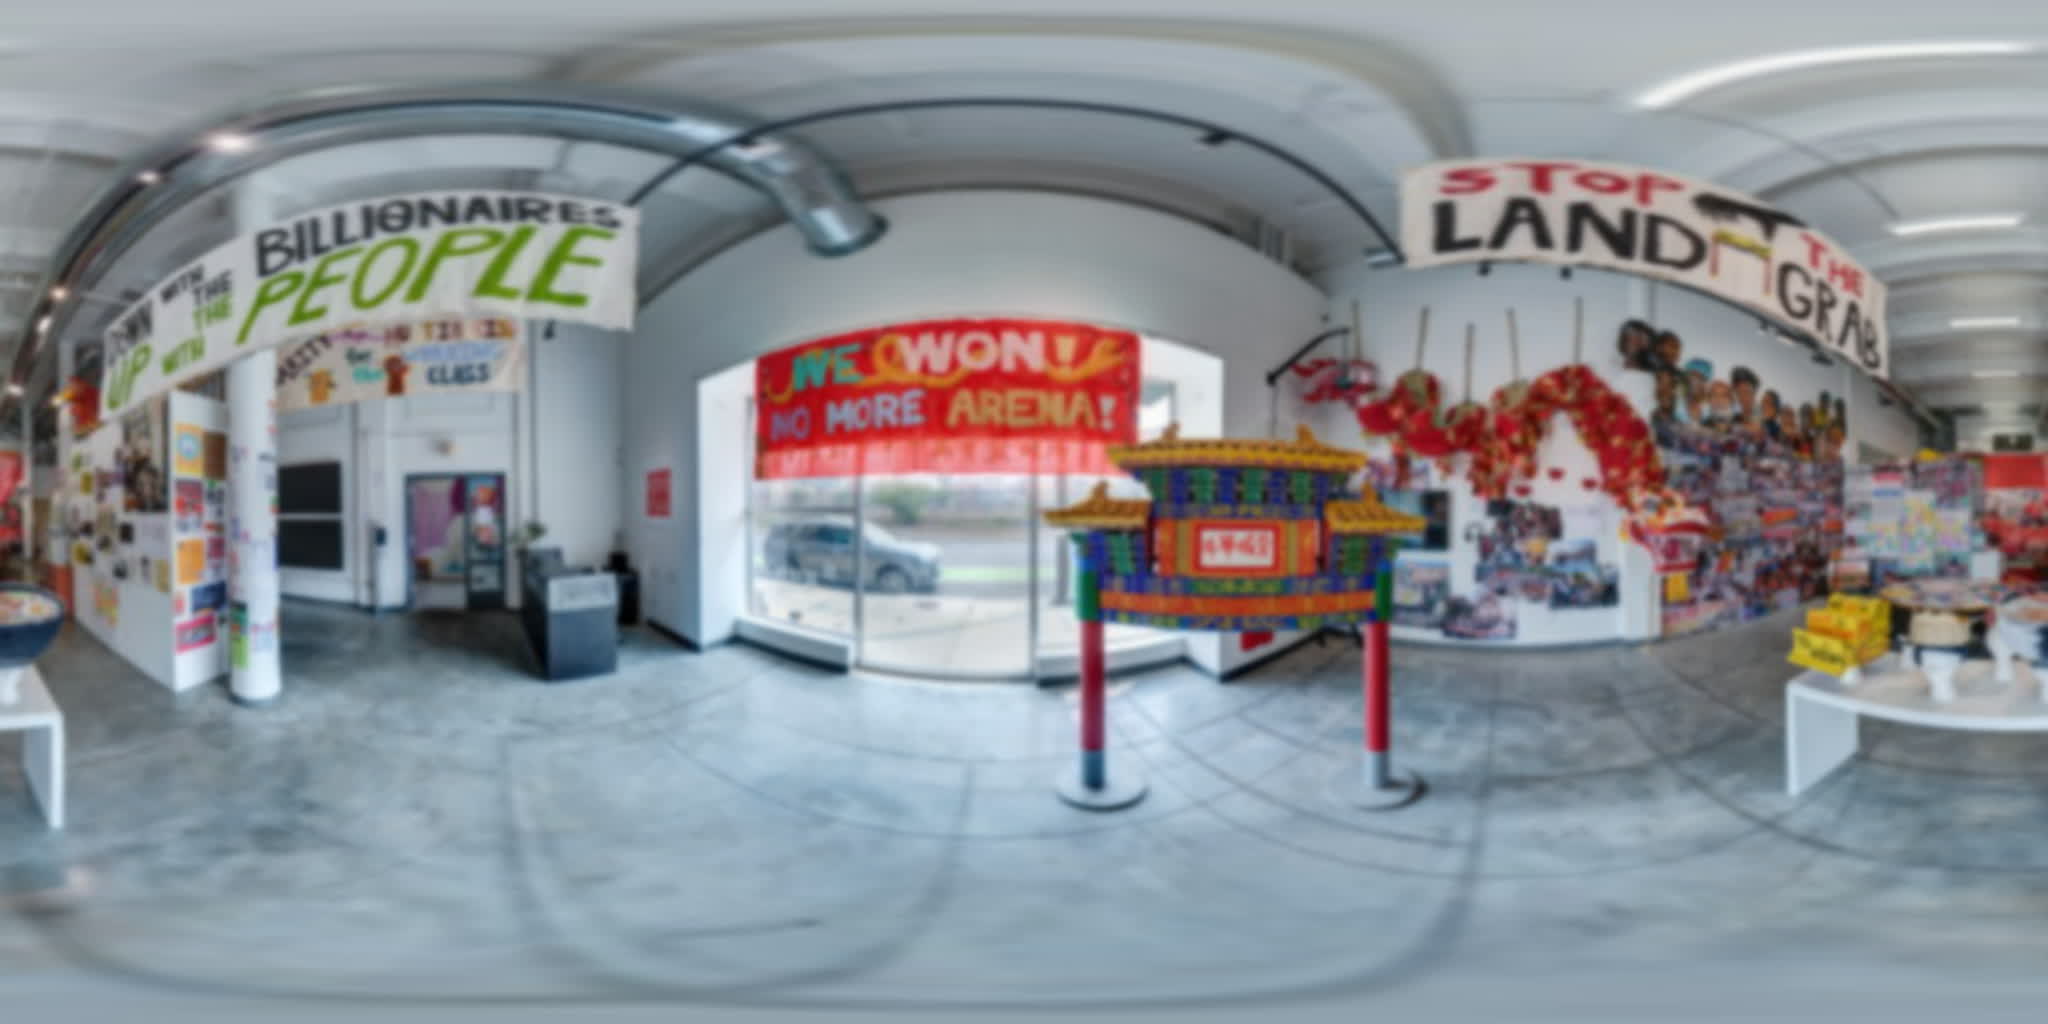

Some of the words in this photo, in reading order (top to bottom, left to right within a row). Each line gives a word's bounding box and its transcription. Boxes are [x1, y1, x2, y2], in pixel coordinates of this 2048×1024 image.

[1438, 163, 1685, 207] STOP
[256, 196, 621, 277] BILLIONAIRES
[1433, 198, 1708, 270] LAND
[1802, 233, 1865, 298] THE
[107, 343, 152, 410] UP
[235, 224, 616, 345] PEOPLE
[1778, 262, 1882, 369] GRAB
[791, 344, 864, 390] WE
[769, 408, 810, 441] NO
[826, 388, 927, 434] MORE
[946, 387, 1117, 430] ARENA!
